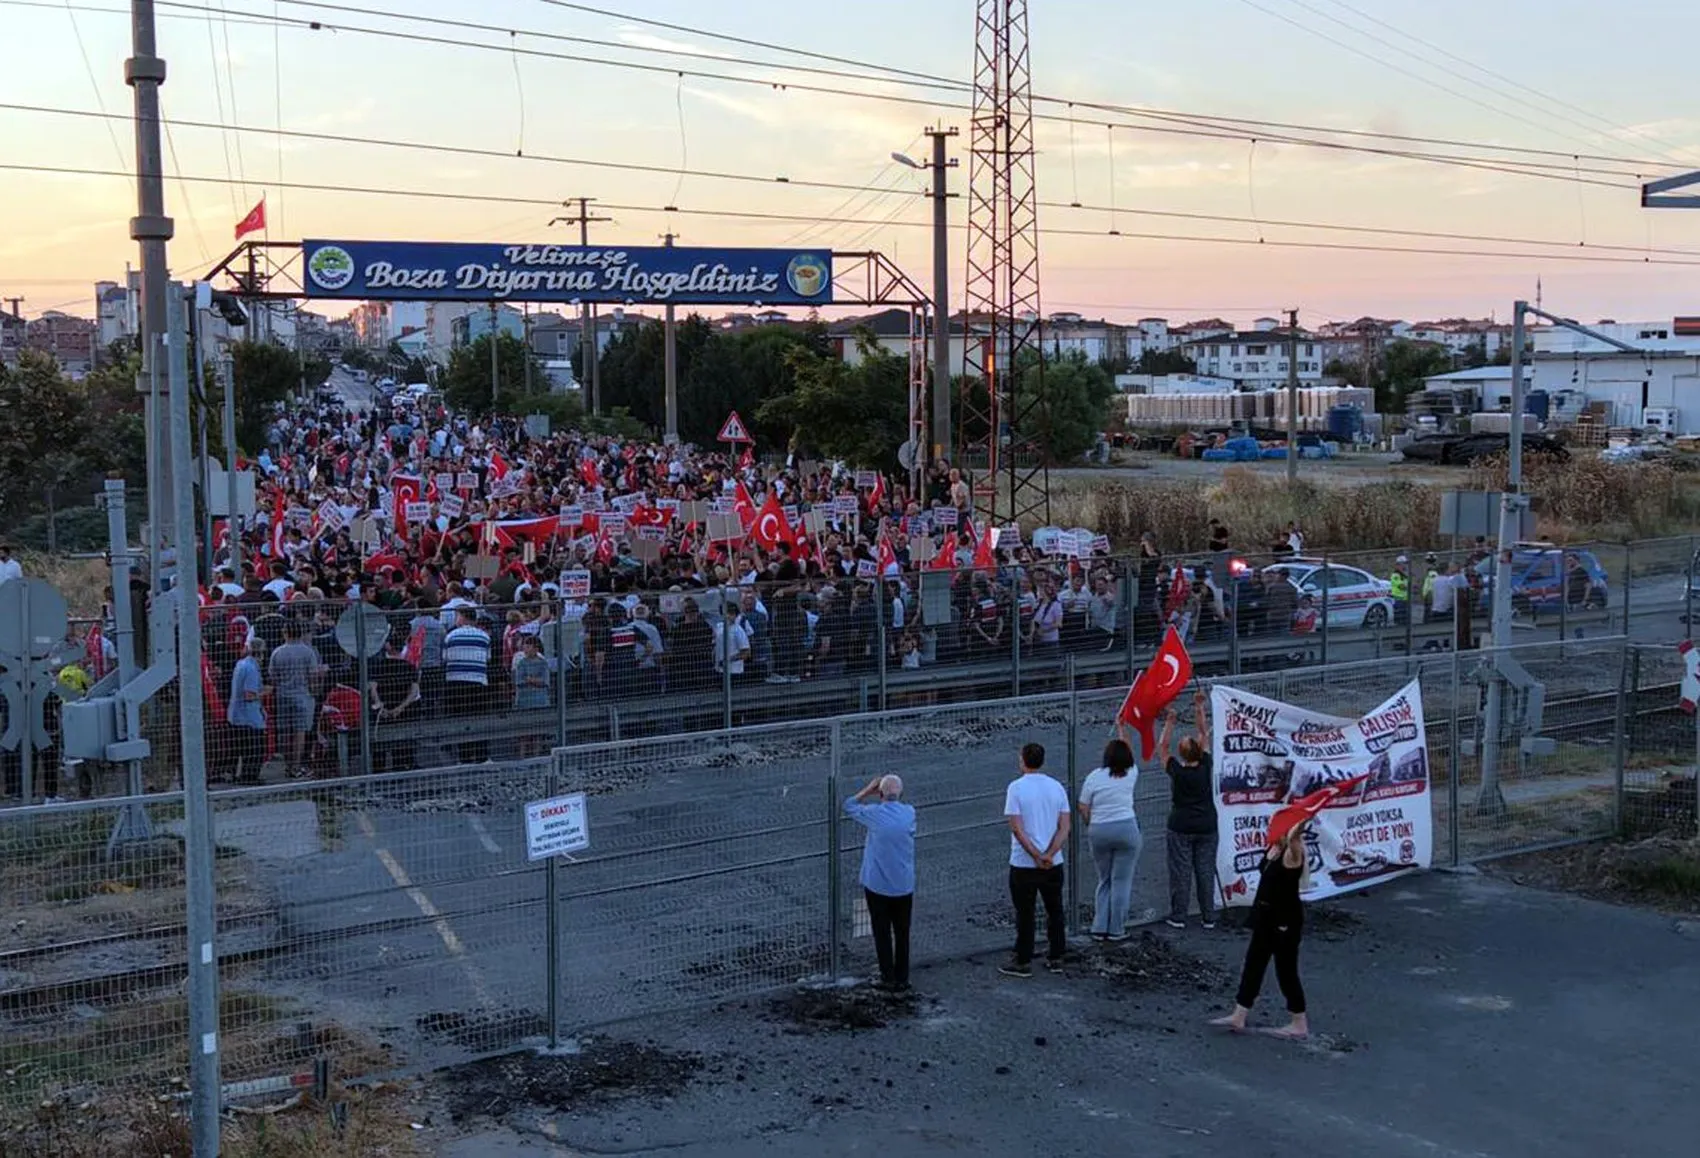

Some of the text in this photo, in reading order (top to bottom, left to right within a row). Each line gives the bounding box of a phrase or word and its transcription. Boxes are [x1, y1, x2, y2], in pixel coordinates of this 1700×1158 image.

[503, 244, 628, 270] Velimeşe
[364, 261, 778, 299] Boza Diyarına Hoşgeldiniz
[1377, 825, 1390, 841] DE
